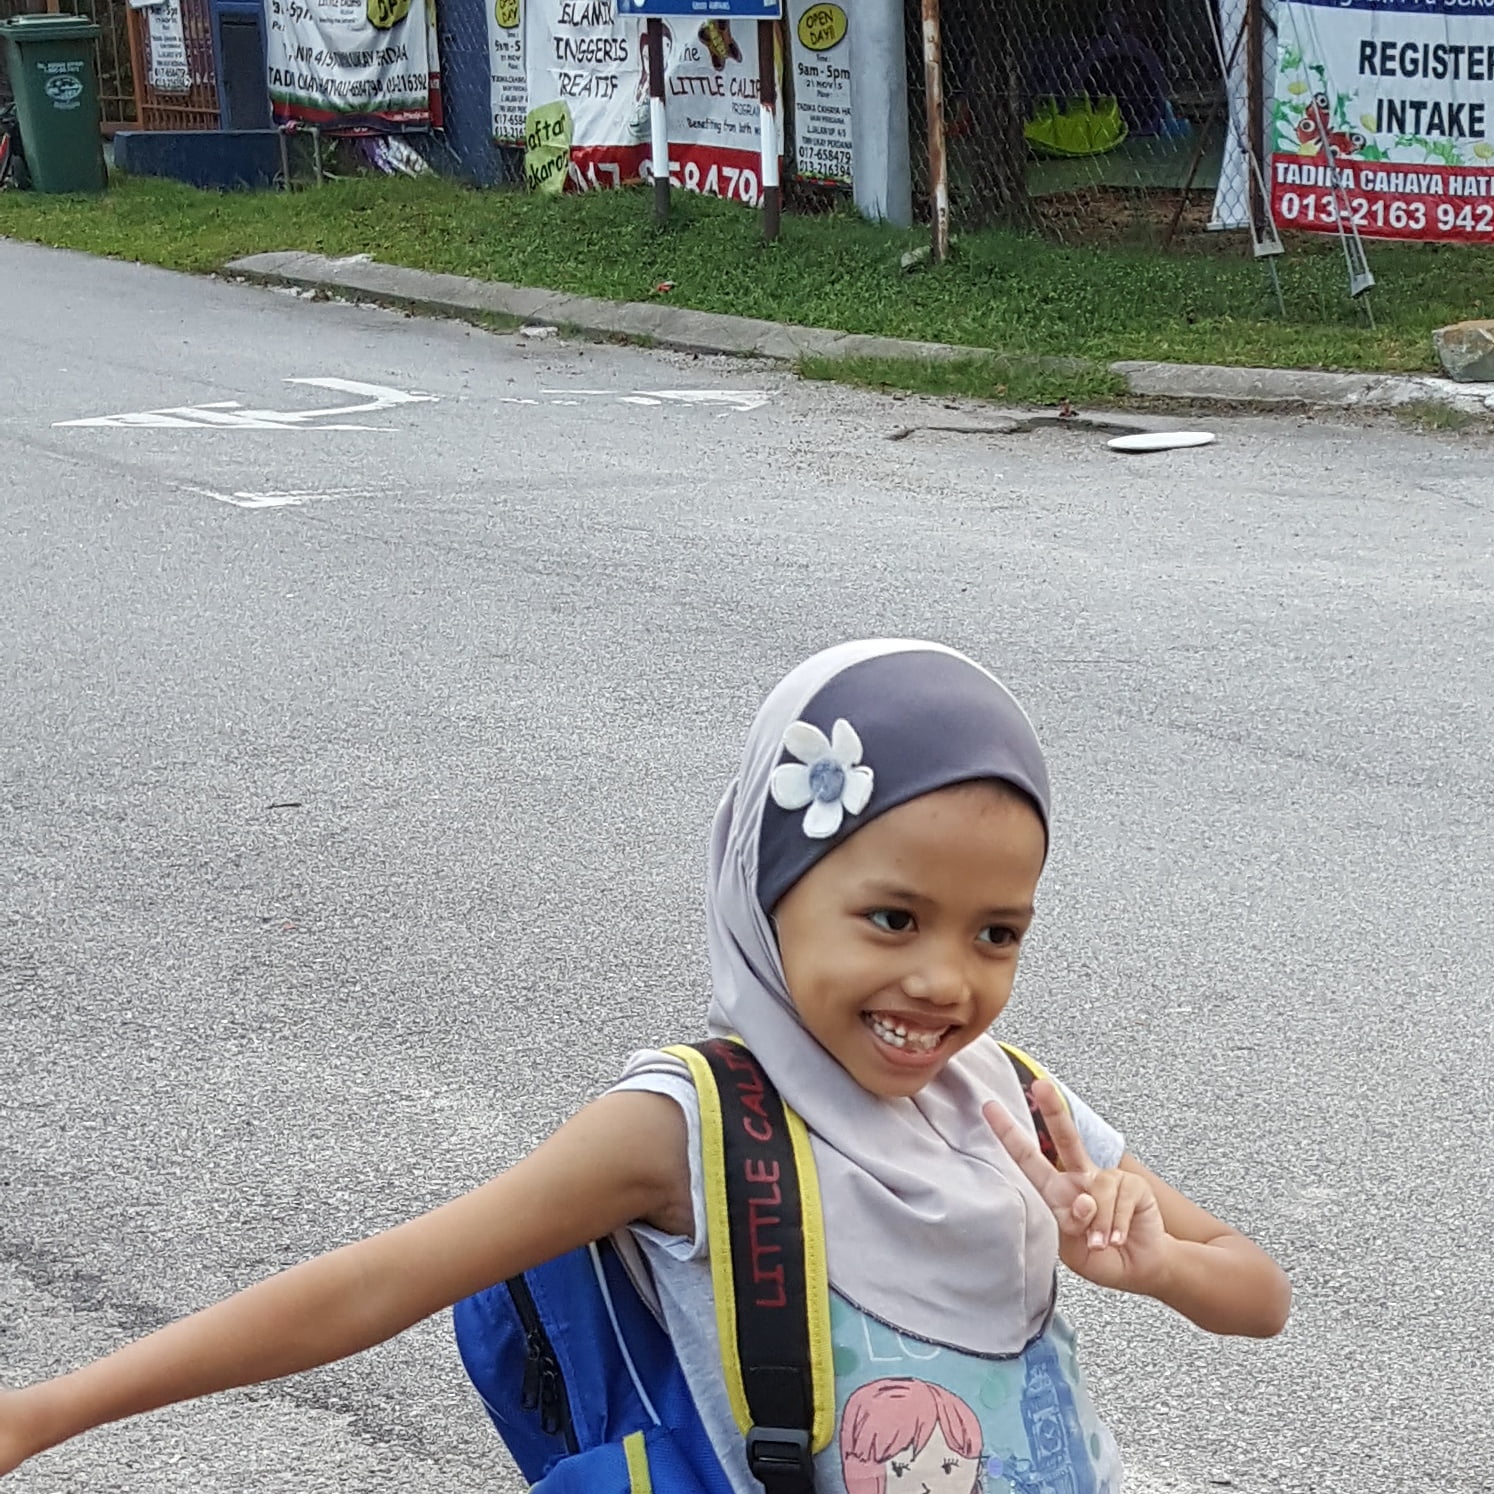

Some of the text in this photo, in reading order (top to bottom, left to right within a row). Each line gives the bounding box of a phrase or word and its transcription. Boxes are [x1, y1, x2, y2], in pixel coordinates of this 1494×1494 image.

[553, 36, 628, 63] INGGERIS
[797, 62, 819, 77] 9am
[826, 64, 851, 81] 5pm
[559, 72, 618, 99] REATIF
[669, 76, 761, 99] LITTLE CALIP
[1375, 98, 1485, 138] INTAKE
[528, 113, 566, 151] aftar
[799, 146, 851, 165] 017-658479
[799, 159, 851, 178] 013-216394
[1276, 162, 1355, 190] TADIKA
[1360, 169, 1444, 195] CAHAYA
[1280, 192, 1494, 232] 013-2163 942
[744, 1158, 788, 1308] LITTLE
